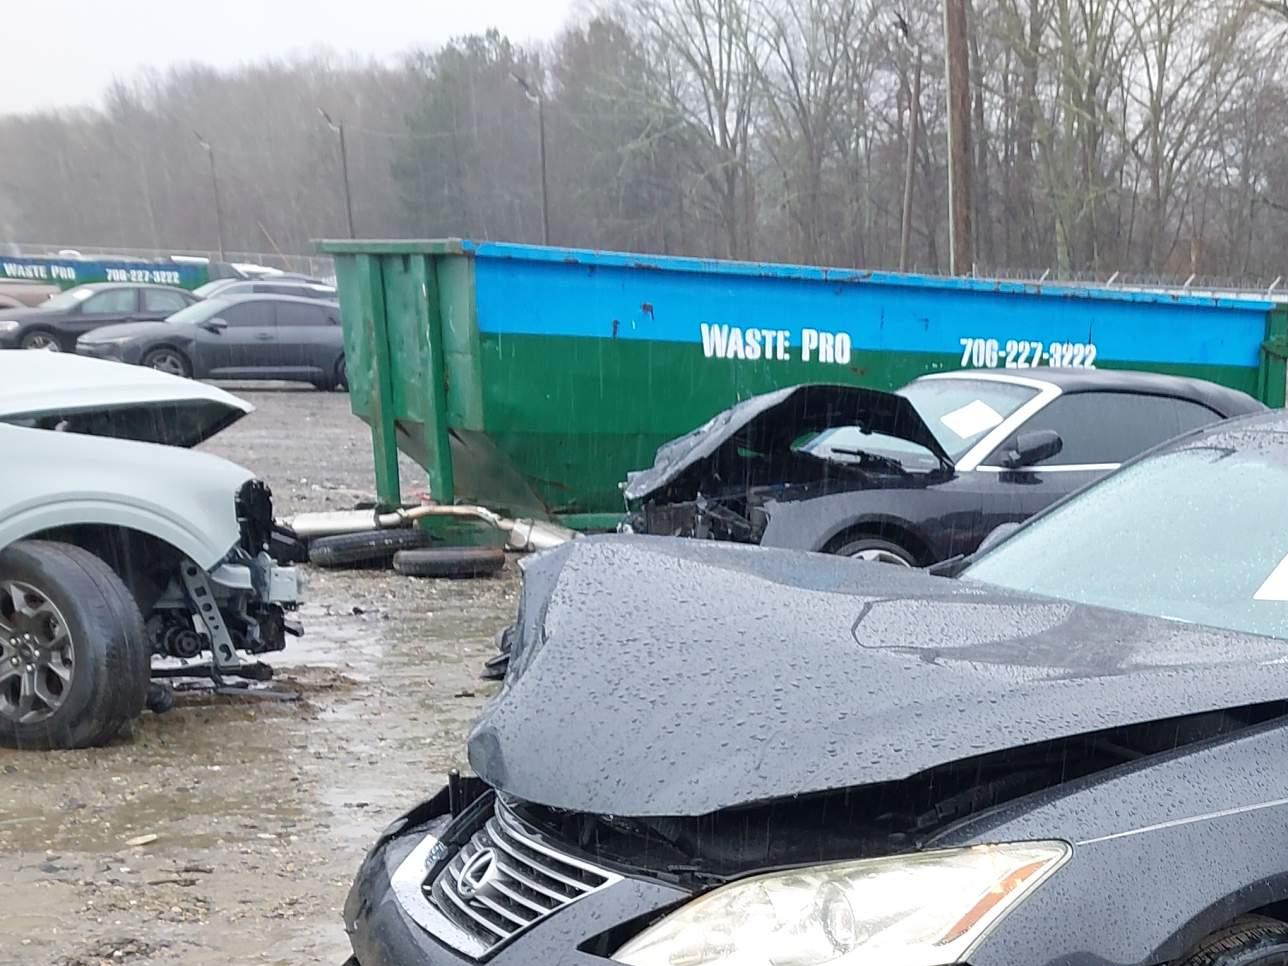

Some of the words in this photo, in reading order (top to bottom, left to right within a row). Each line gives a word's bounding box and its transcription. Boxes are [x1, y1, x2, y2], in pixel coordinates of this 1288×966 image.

[3, 263, 47, 279] WASTE
[51, 265, 76, 280] PRO
[701, 323, 790, 360] WASTE
[801, 328, 852, 364] PRO
[959, 337, 1097, 370] 706-227-3222
